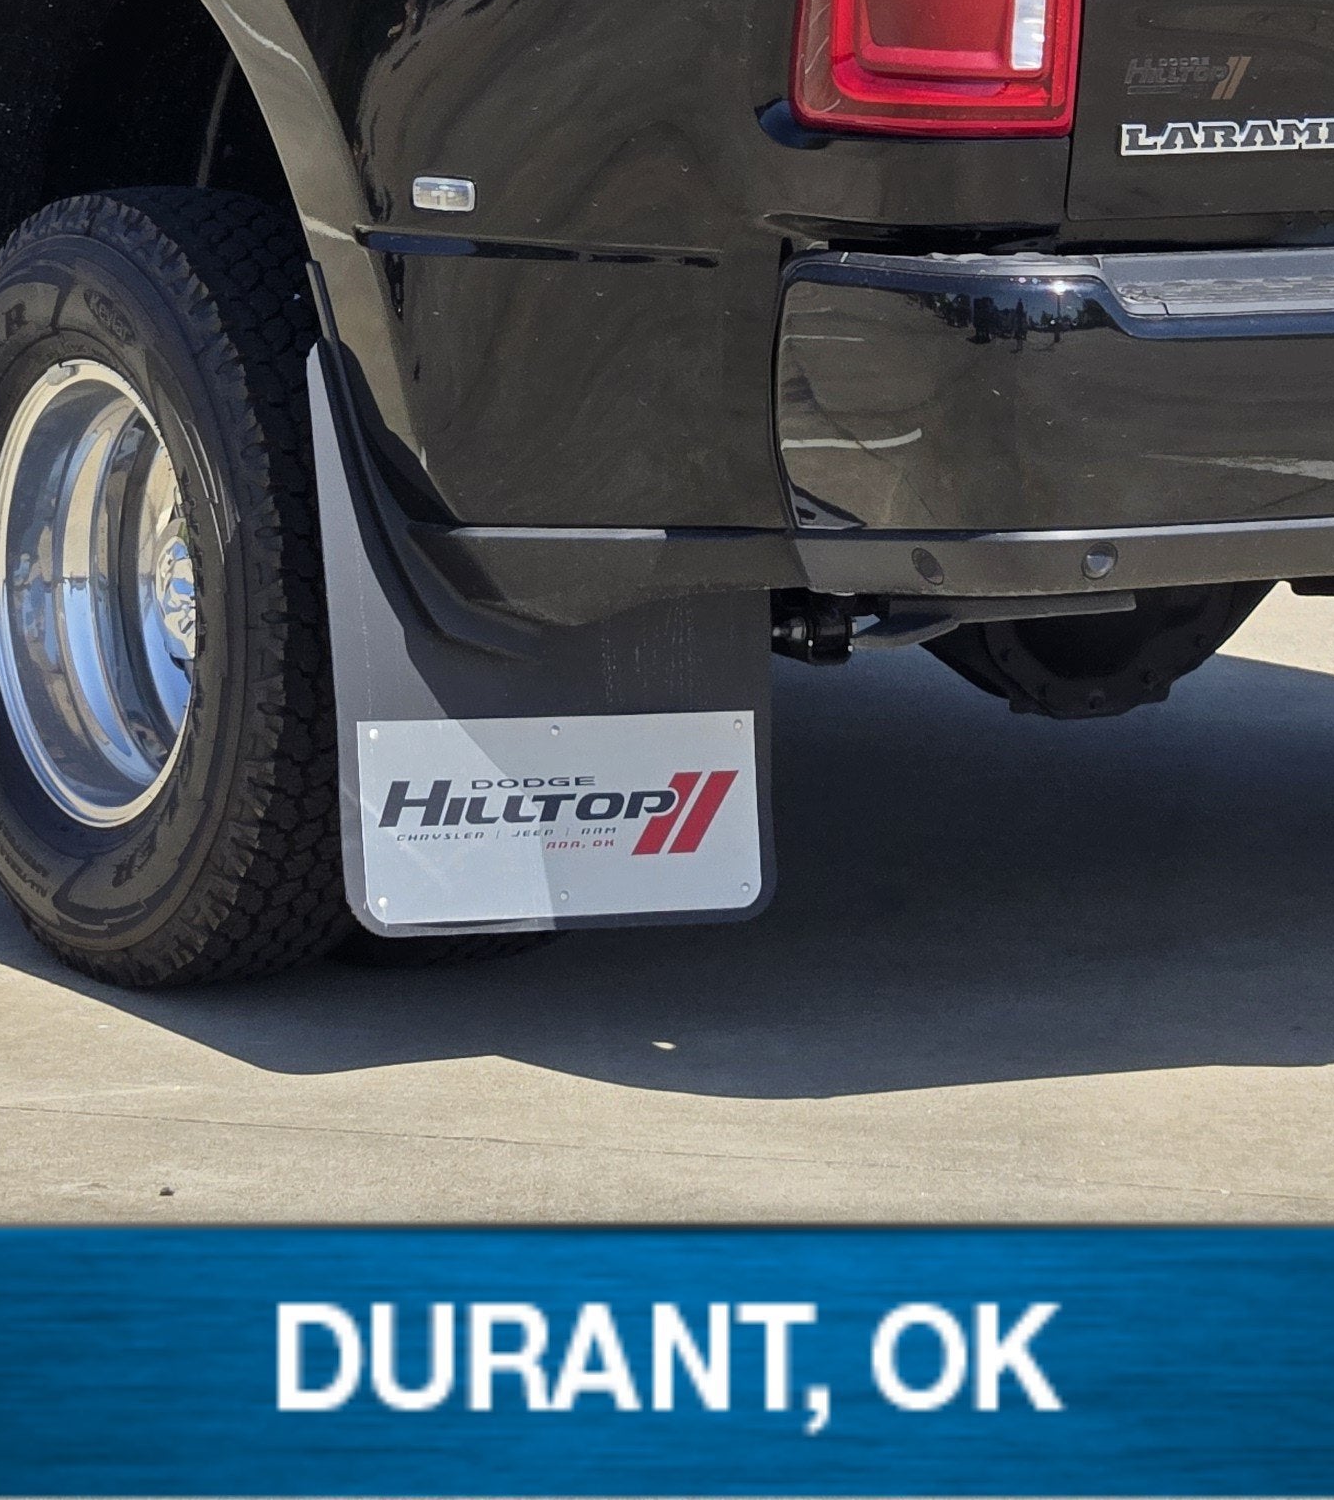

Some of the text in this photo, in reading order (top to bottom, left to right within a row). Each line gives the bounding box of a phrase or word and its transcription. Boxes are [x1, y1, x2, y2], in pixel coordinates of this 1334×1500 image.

[470, 775, 596, 790] DODGE
[378, 778, 677, 828] HILLTOP
[395, 830, 486, 842] CHRYSLER
[510, 828, 555, 837] JEEP
[591, 838, 616, 848] OK
